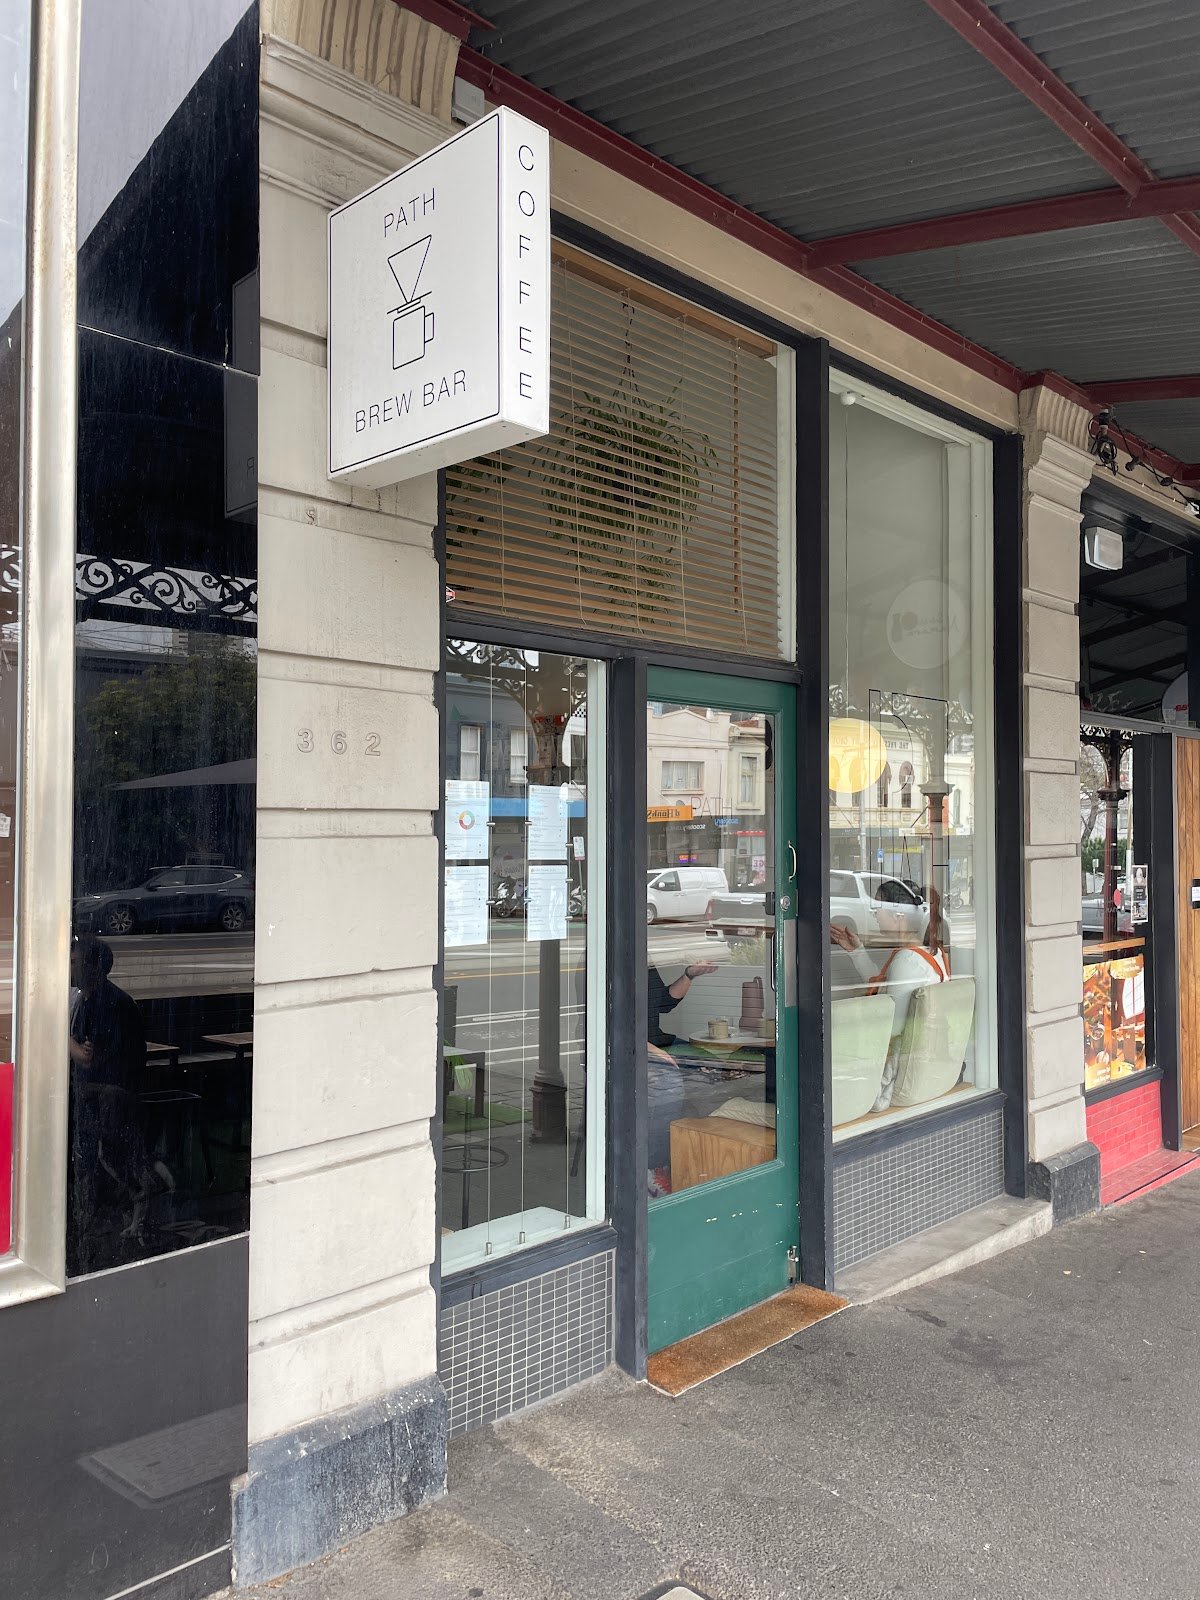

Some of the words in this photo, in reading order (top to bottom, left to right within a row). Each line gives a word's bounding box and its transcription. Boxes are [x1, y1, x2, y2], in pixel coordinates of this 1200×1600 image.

[384, 187, 436, 238] PATH
[517, 145, 536, 399] COFFEE
[355, 389, 413, 433] BREW
[423, 369, 467, 407] BAR
[296, 728, 382, 757] 362
[691, 796, 733, 819] PATH
